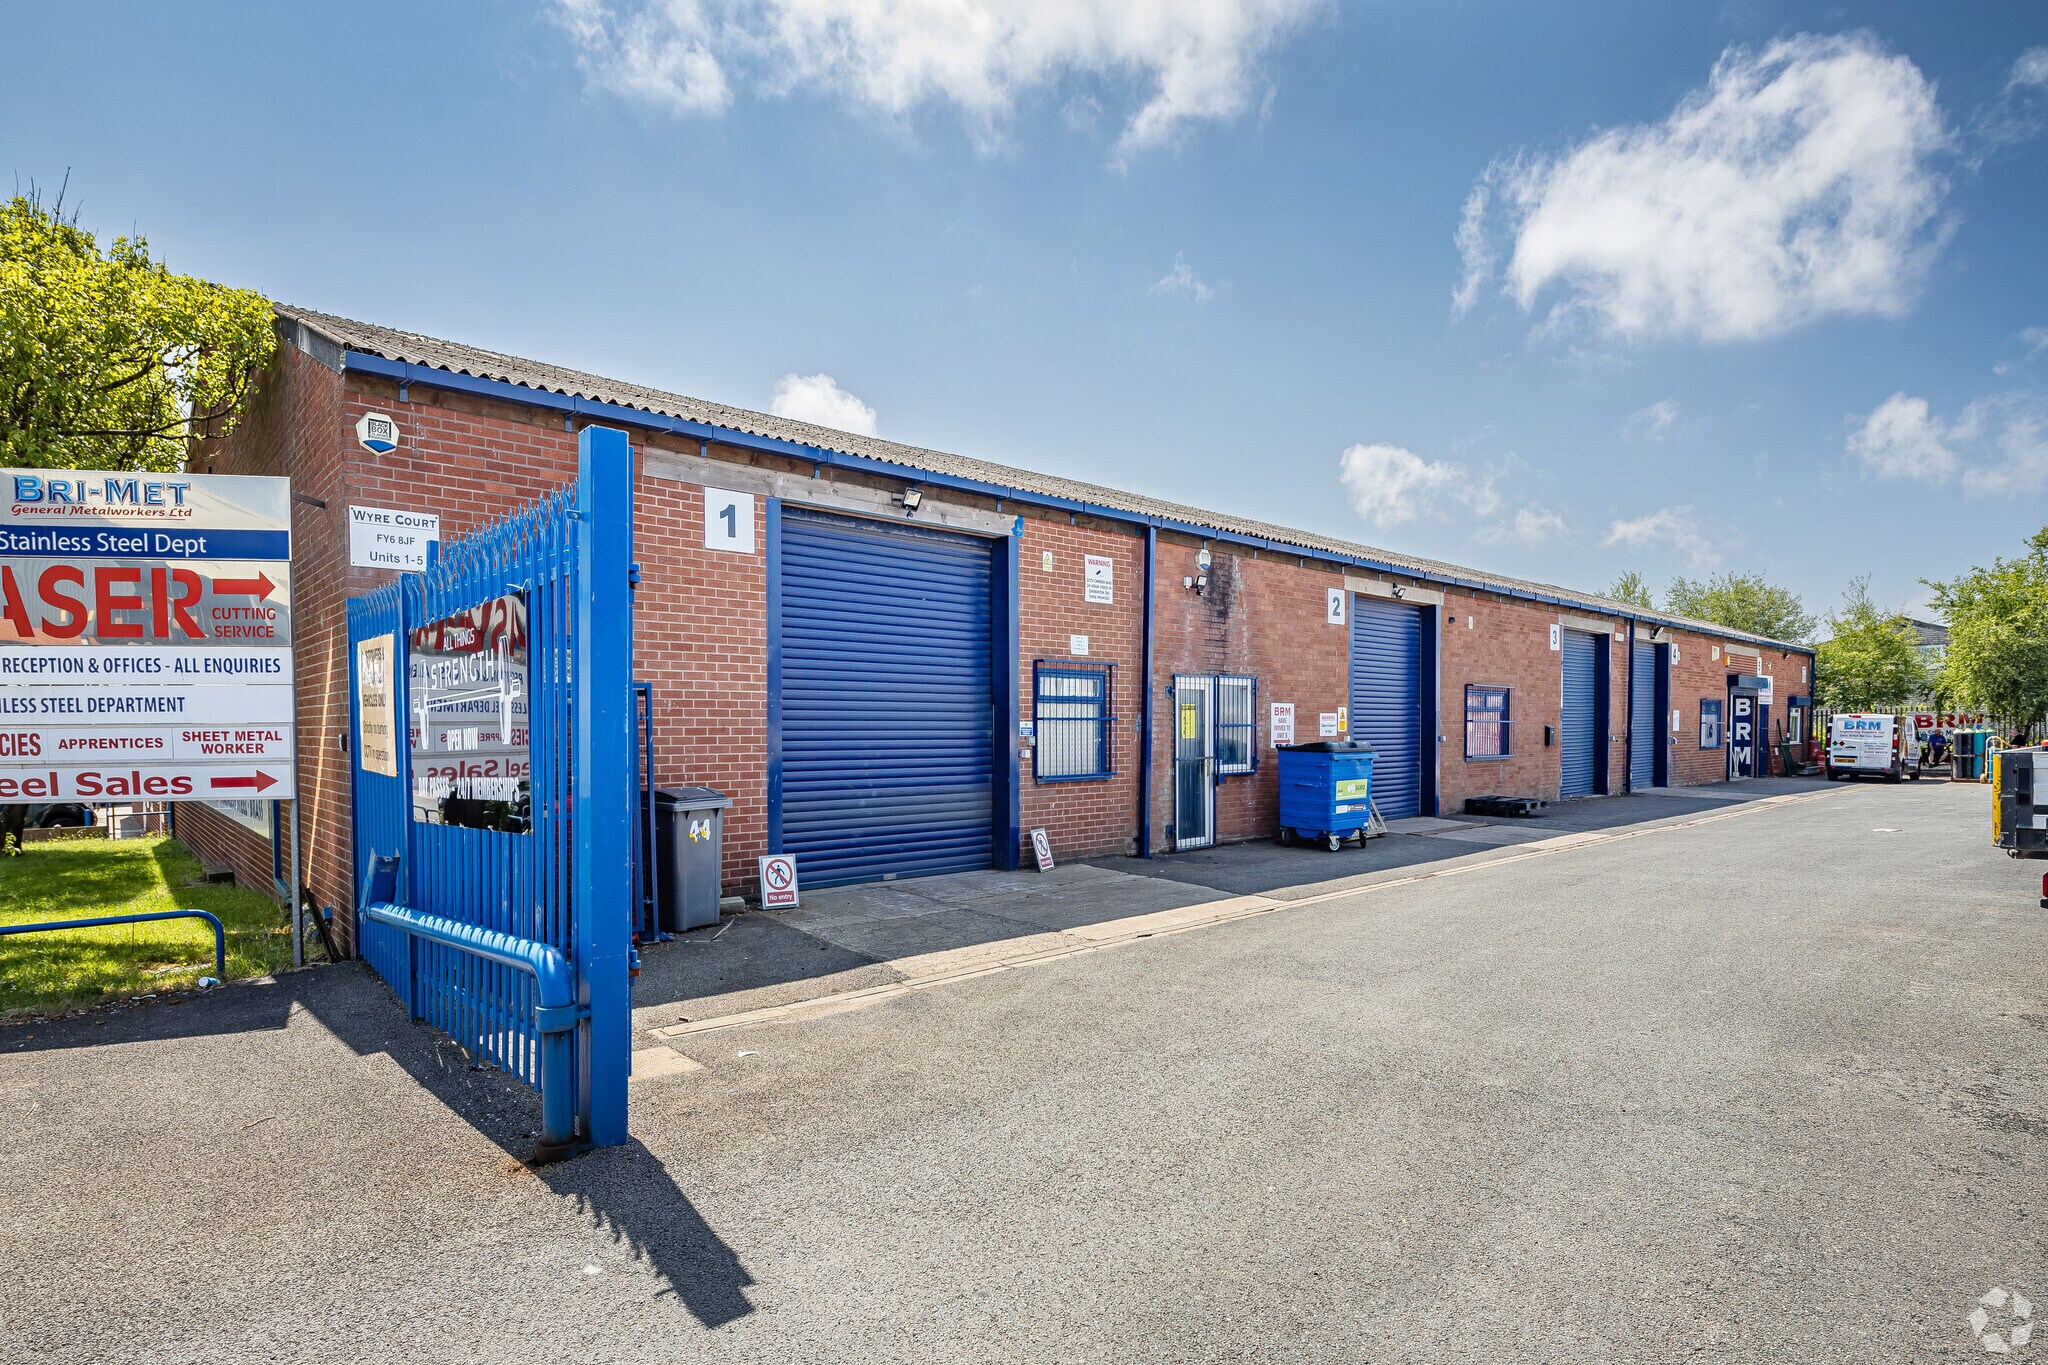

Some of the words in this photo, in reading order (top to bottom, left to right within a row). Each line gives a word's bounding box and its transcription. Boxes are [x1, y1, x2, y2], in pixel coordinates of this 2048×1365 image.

[371, 426, 388, 435] BOX
[11, 504, 66, 516] General
[69, 506, 165, 517] Metalworkers
[169, 508, 192, 517] Ltd
[352, 510, 390, 524] WYRE
[395, 515, 437, 529] COURT
[719, 504, 736, 538] 1
[0, 531, 91, 551] Stainless
[97, 533, 148, 552] Steel
[155, 534, 207, 557] Dept
[377, 534, 395, 544] FY6
[398, 536, 415, 546] 8JF
[369, 551, 400, 564] Units
[1088, 558, 1111, 567] WARNING
[212, 607, 276, 621] CUTTING
[1332, 597, 1340, 616] 2
[214, 625, 274, 638] SERVICE
[1552, 630, 1558, 645] 3
[443, 636, 453, 652] ALL
[454, 628, 475, 648] THINGS
[2, 658, 84, 673] RECEPTION
[88, 658, 99, 673] &
[103, 658, 161, 673] OFFICES
[174, 658, 200, 673] ALL
[204, 658, 281, 675] ENQUIRIES
[431, 649, 494, 690] STRENGTH
[0, 698, 37, 713] LESS
[41, 698, 83, 713] STEEL
[87, 697, 185, 713] DEPARTMENT
[1274, 707, 1291, 716] BRM
[1732, 698, 1751, 764] BRM
[1843, 720, 1881, 730] BRM
[58, 738, 164, 749] APPRENTICES
[182, 731, 229, 742] SHEET
[235, 731, 282, 742] METAL
[447, 729, 462, 751] OPEN
[463, 727, 478, 750] NOW
[0, 733, 41, 756] CIES
[201, 743, 265, 754] WORKER
[0, 771, 59, 797] eel
[76, 771, 193, 796] Sales
[456, 777, 471, 799] 24/7
[472, 777, 519, 802] MEMBERSHIPS
[769, 893, 777, 901] No
[778, 893, 792, 901] entry
